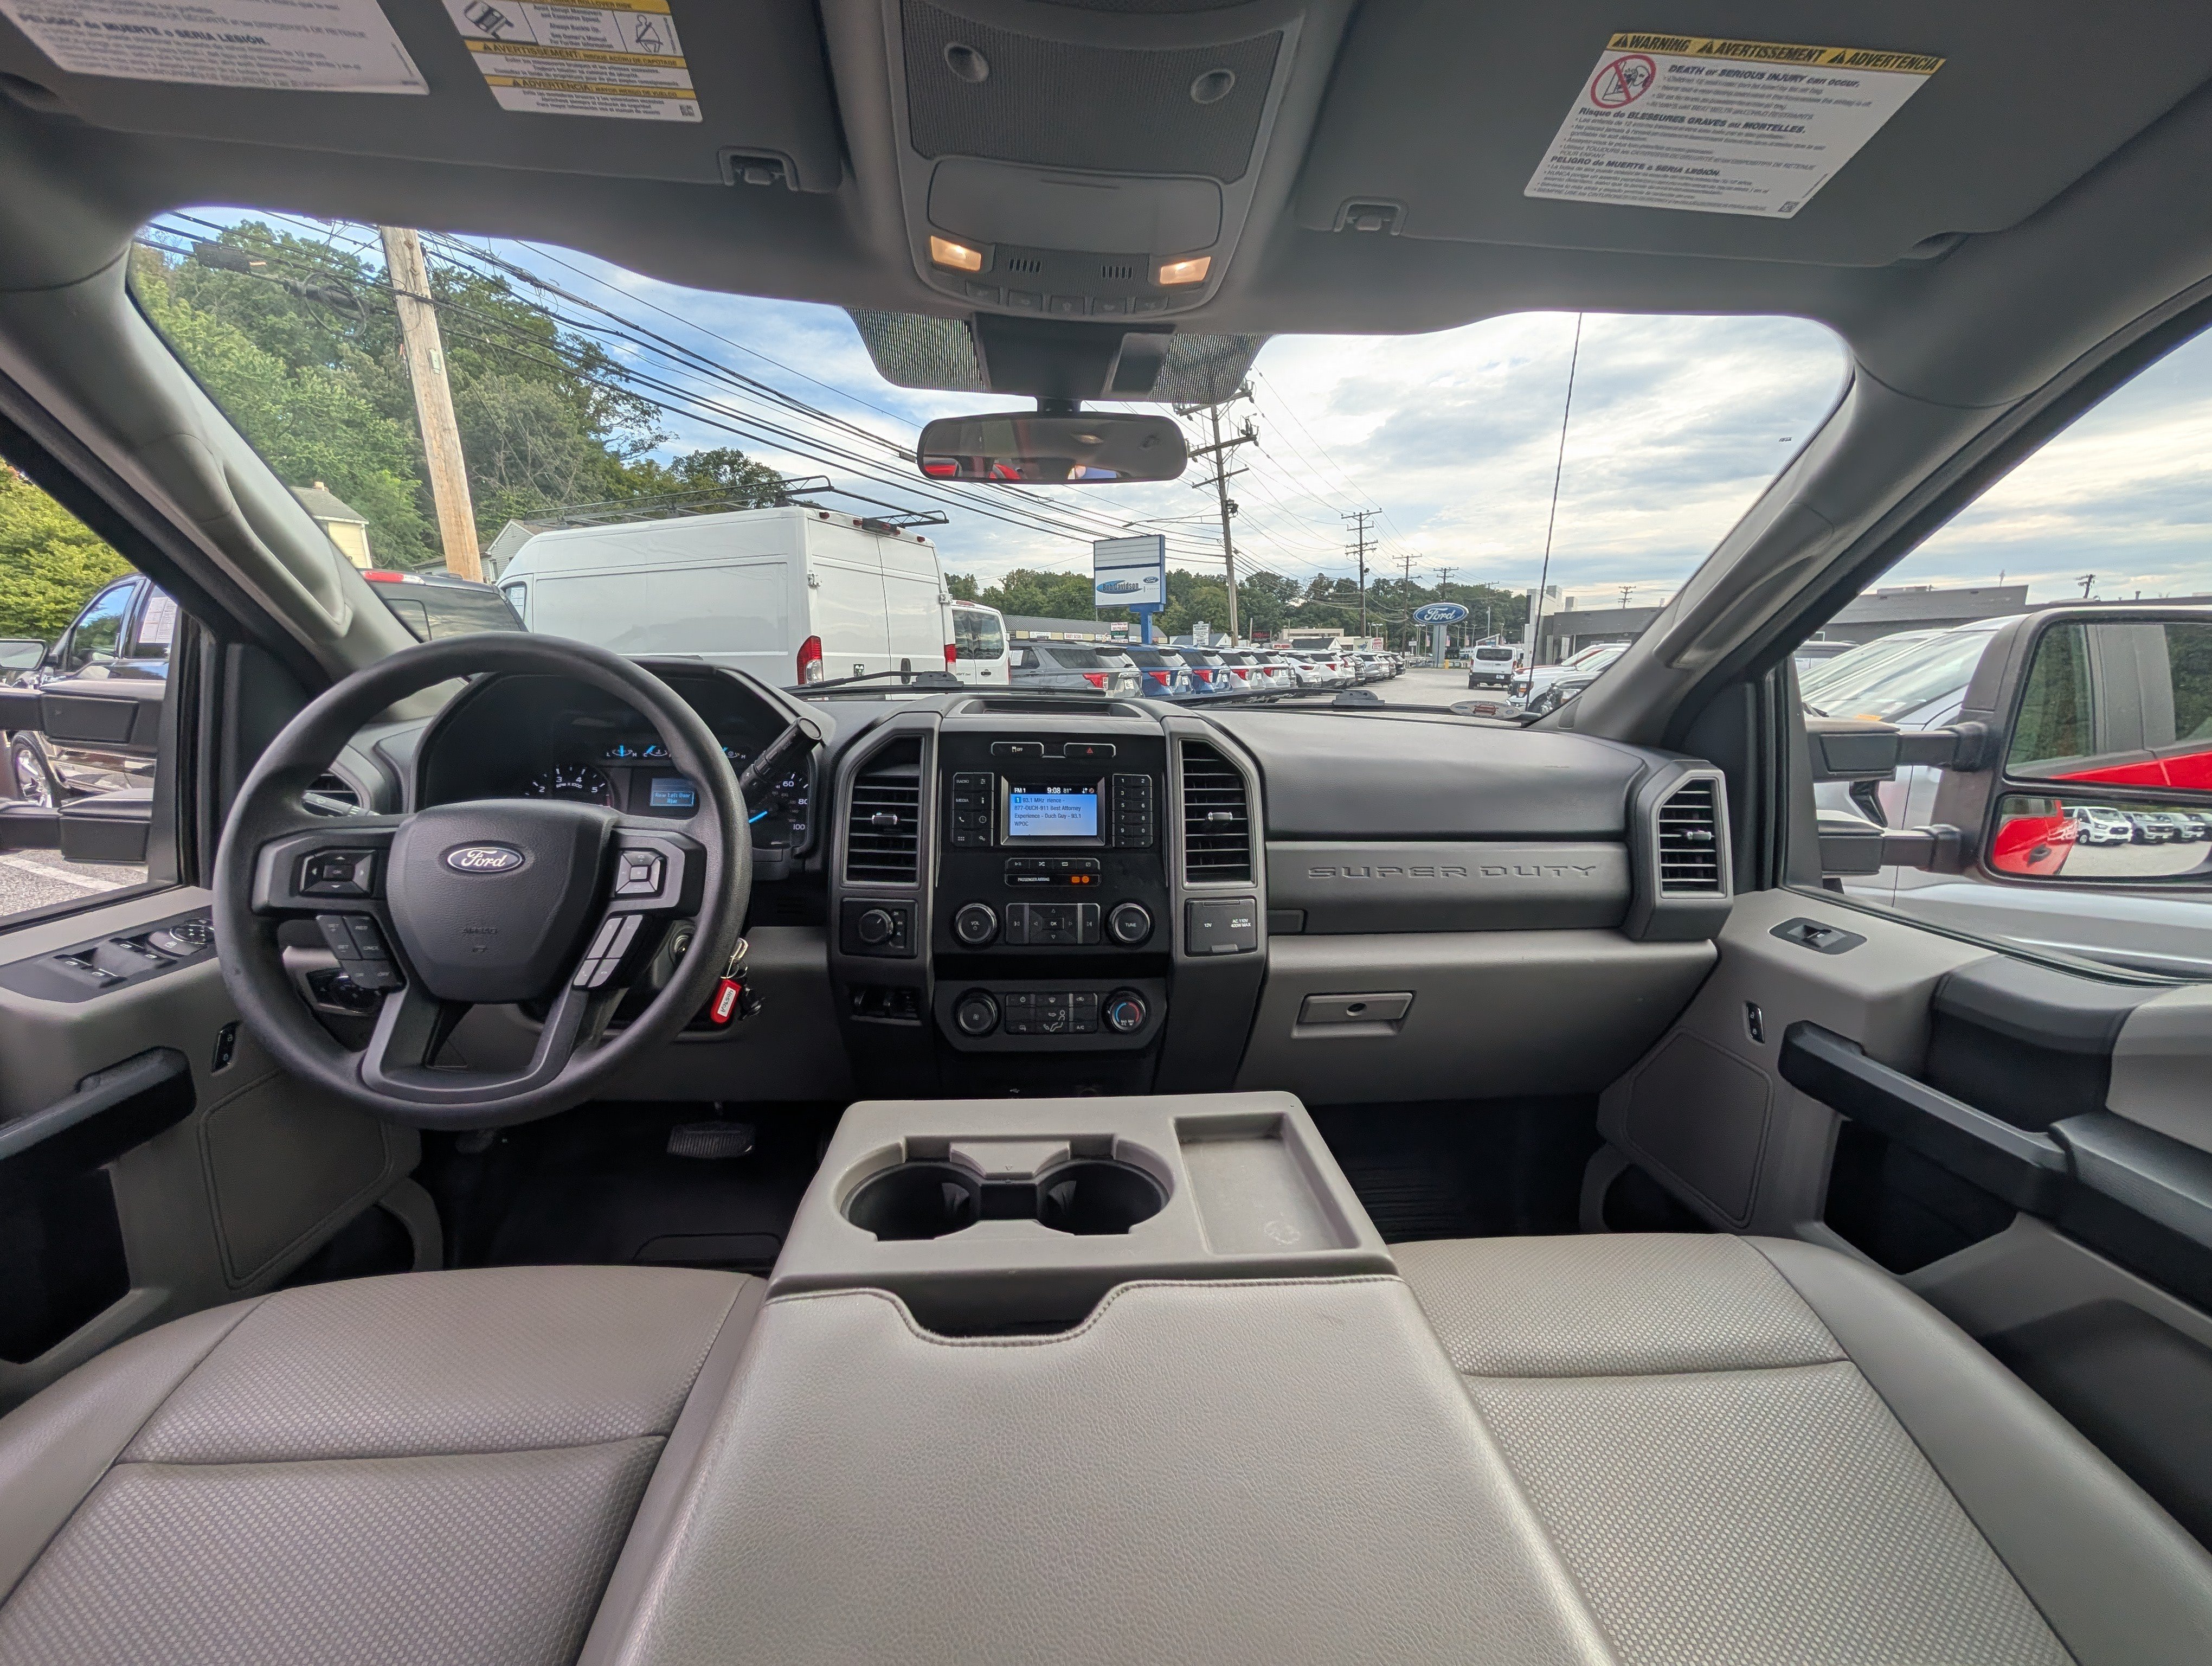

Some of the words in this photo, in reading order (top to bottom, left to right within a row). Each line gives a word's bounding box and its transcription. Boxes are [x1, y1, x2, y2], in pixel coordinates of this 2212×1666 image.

[20, 13, 81, 27] PELIGRO
[83, 20, 101, 29] de
[102, 22, 162, 36] MUERTE
[175, 29, 216, 41] SERIA
[1628, 34, 1692, 53] WARNING
[1713, 41, 1827, 64] AVERTISSEMENT
[1845, 52, 1943, 72] ADVERTENCIA
[1668, 64, 1706, 76] DEATH
[1718, 68, 1766, 80] SERIOUS
[1765, 72, 1808, 83] INJURY
[1579, 108, 1610, 118] Risque
[1628, 112, 1684, 123] BLESSURES
[1688, 117, 1726, 126] GRAVES
[1551, 156, 1590, 164] PELIGRO
[1606, 161, 1644, 169] MUERTE
[1103, 583, 1113, 591] Bob
[1114, 582, 1139, 591] Davidson
[1424, 607, 1456, 621] Ford
[461, 849, 508, 867] Ford
[1308, 866, 1468, 879] SUPER
[1480, 865, 1597, 879] DUTY
